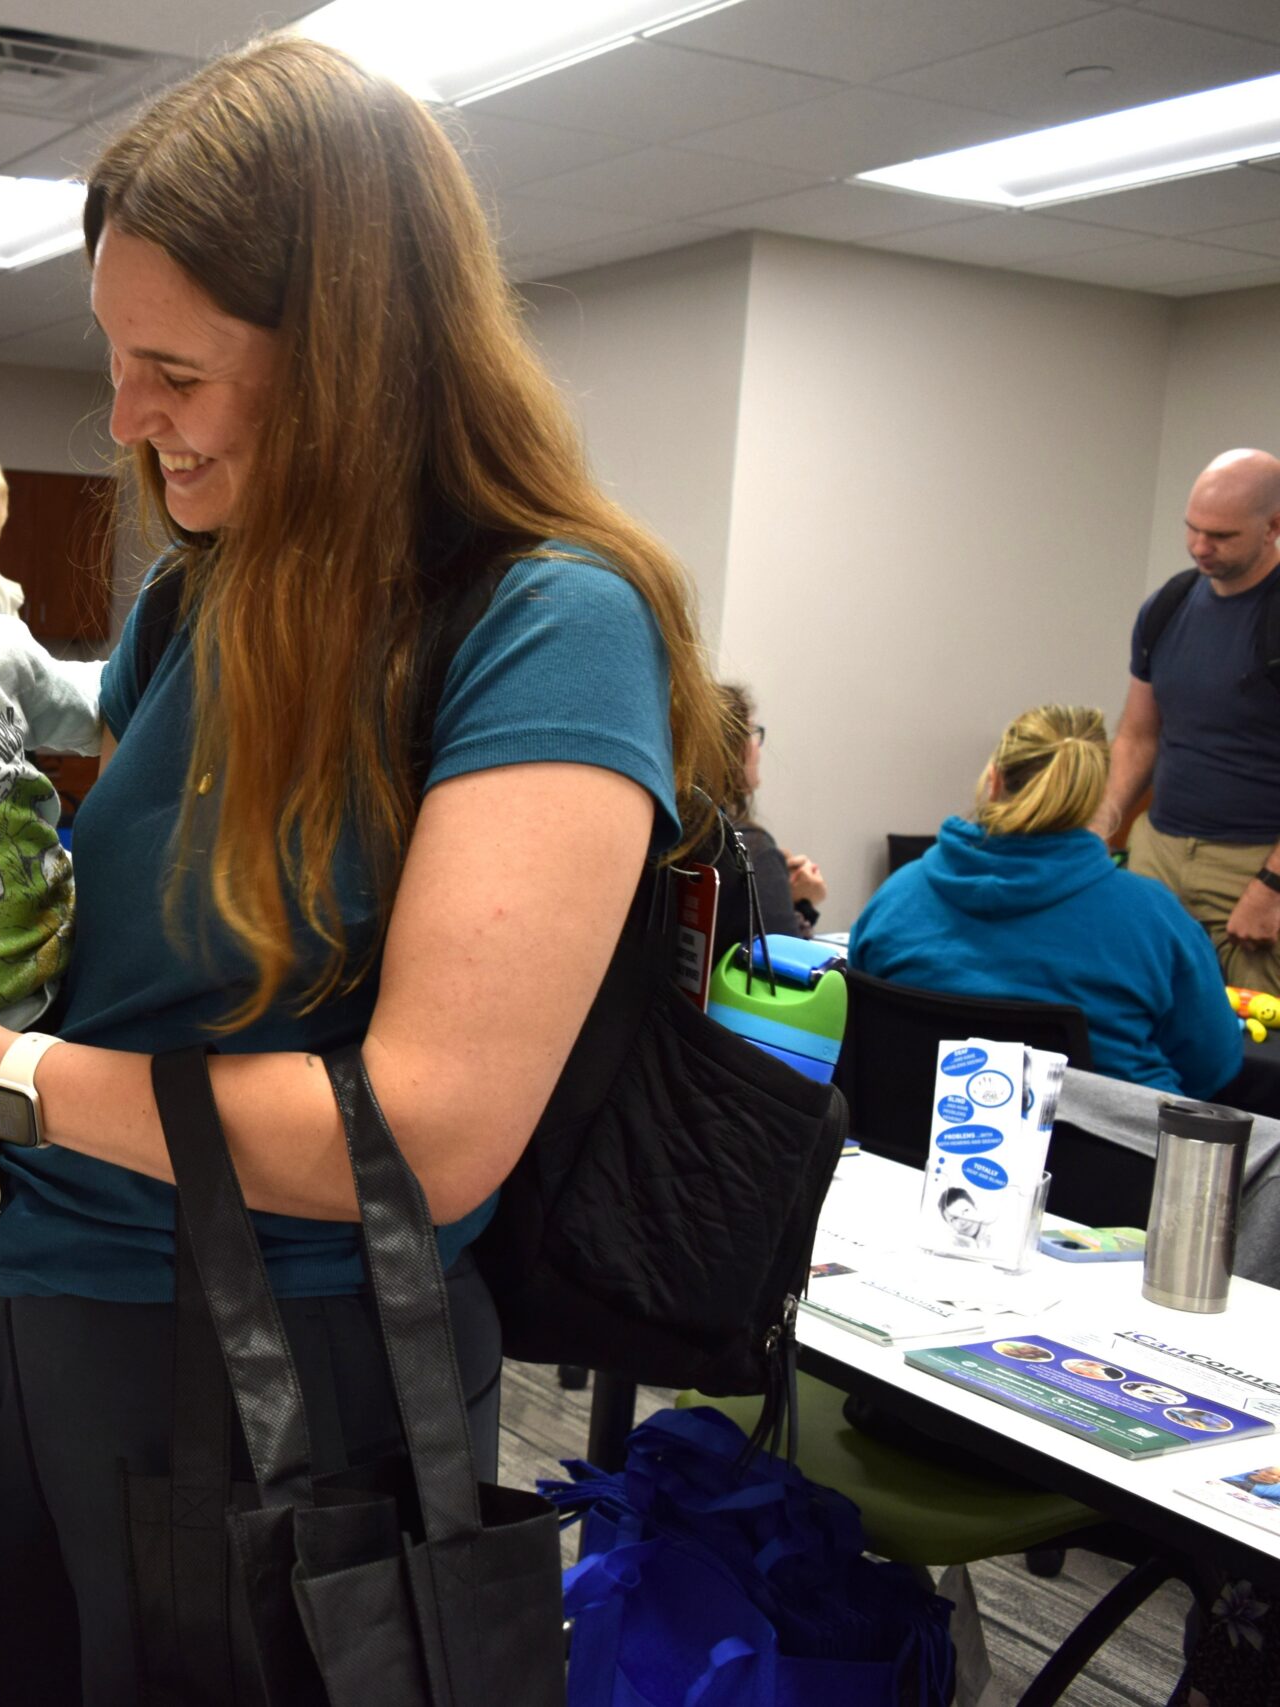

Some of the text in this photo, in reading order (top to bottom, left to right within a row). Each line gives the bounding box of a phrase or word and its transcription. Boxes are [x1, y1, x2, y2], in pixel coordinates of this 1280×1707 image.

[944, 1132, 976, 1140] PROBLEMS
[973, 1162, 999, 1176] TOTALLY
[1122, 1330, 1280, 1391] iCanConne
